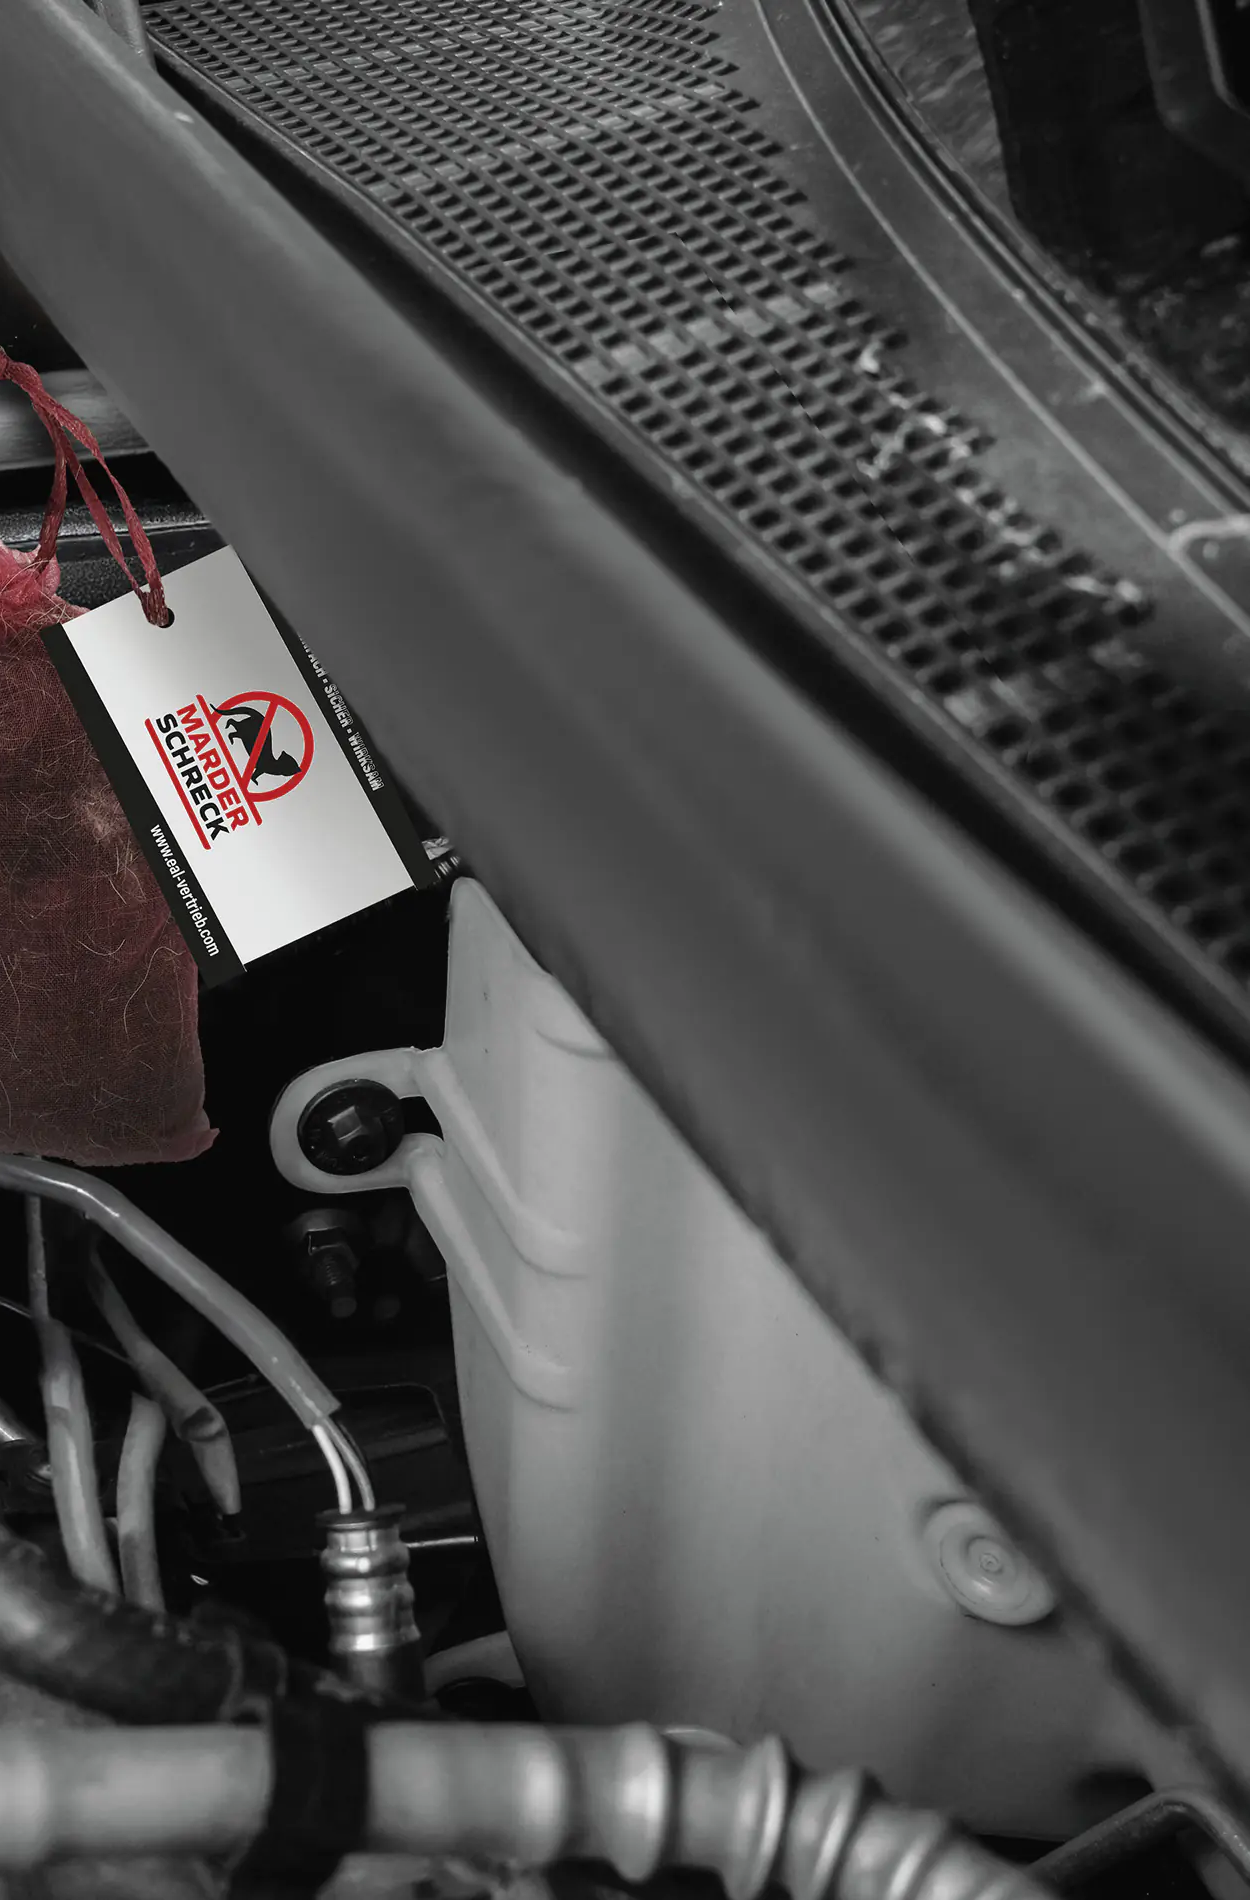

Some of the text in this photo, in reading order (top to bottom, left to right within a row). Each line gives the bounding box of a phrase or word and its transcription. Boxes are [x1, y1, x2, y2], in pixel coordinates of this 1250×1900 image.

[155, 713, 230, 841] SCHRECK
[176, 703, 250, 831] MARDER
[324, 683, 385, 791] SICHER WIRKSAM
[150, 824, 220, 957] www.eal-vertrieb.com
